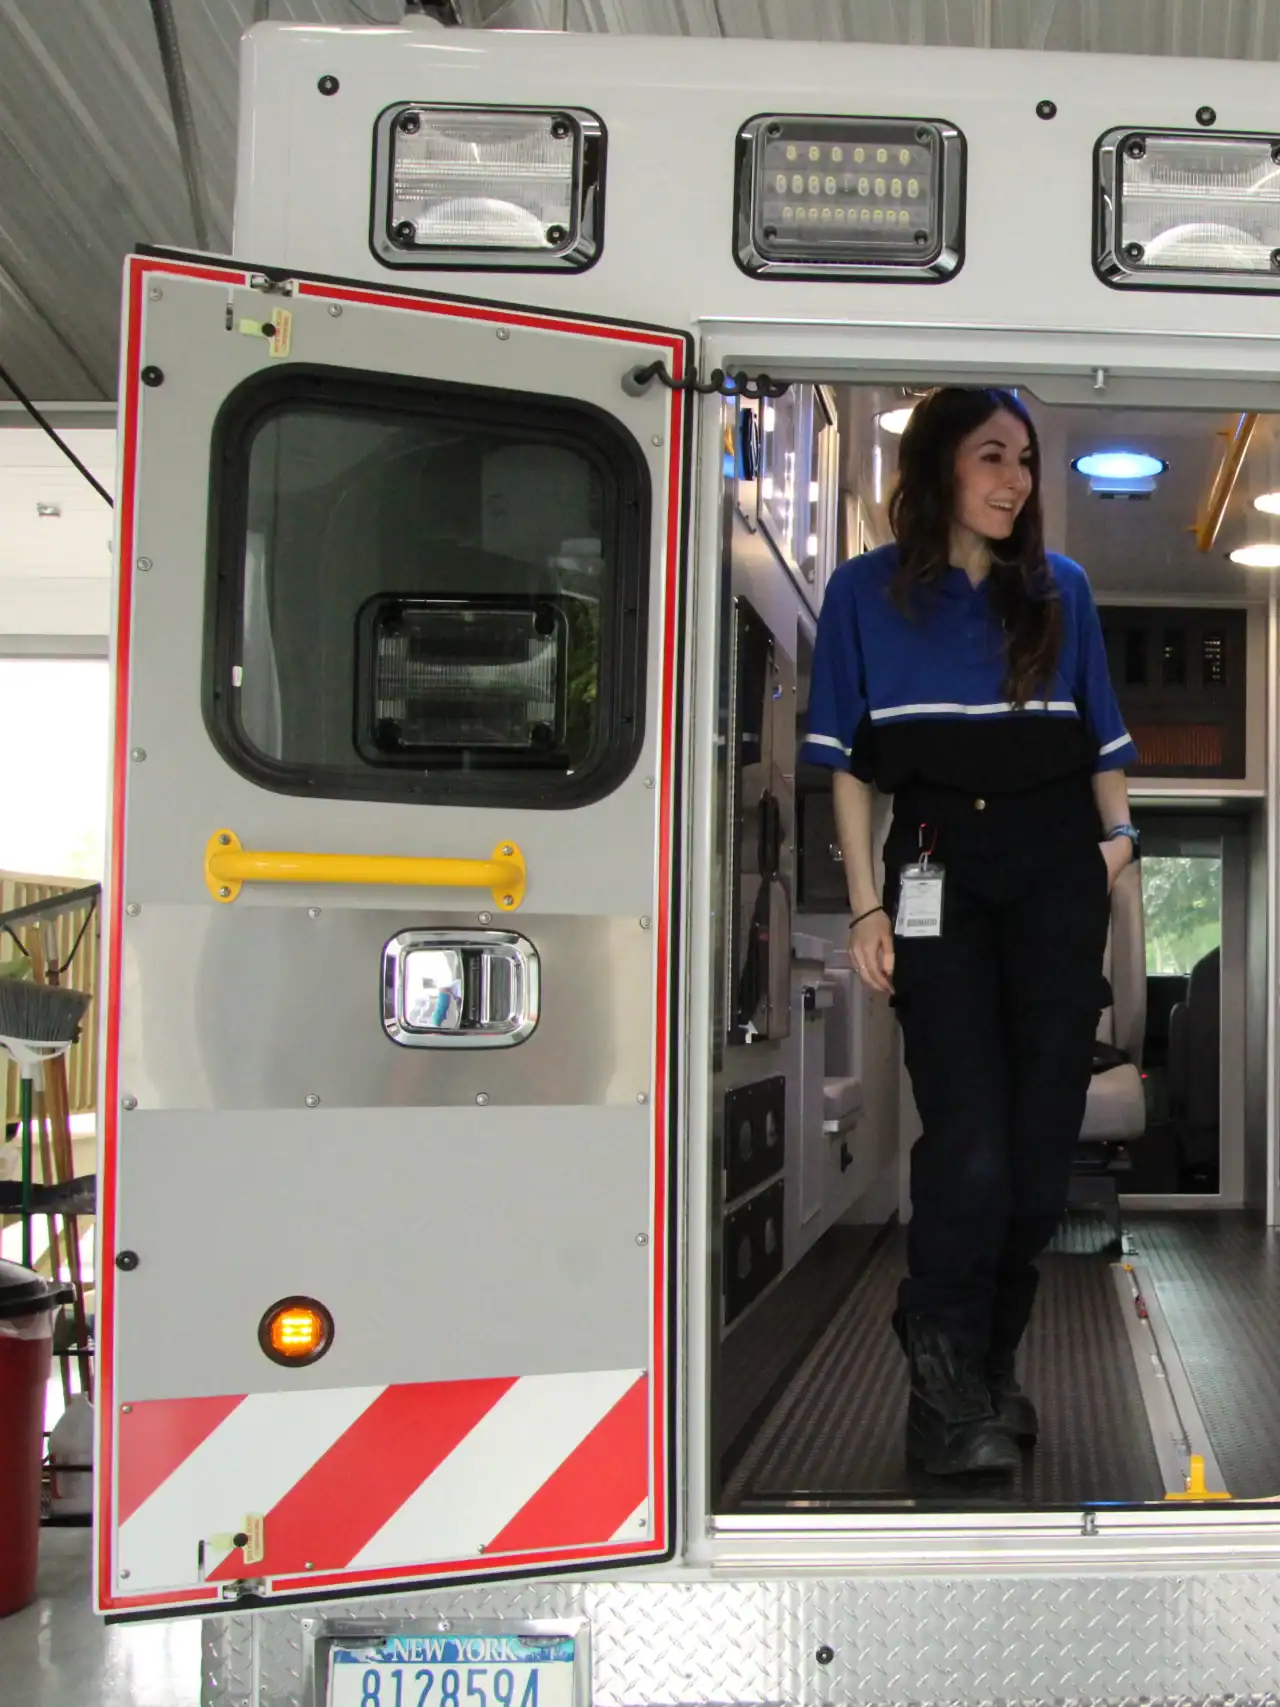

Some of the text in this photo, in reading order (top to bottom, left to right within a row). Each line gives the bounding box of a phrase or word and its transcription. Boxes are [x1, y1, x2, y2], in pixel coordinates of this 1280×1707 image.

[393, 1638, 518, 1661] NEW YORK
[360, 1668, 539, 1707] 8128594
